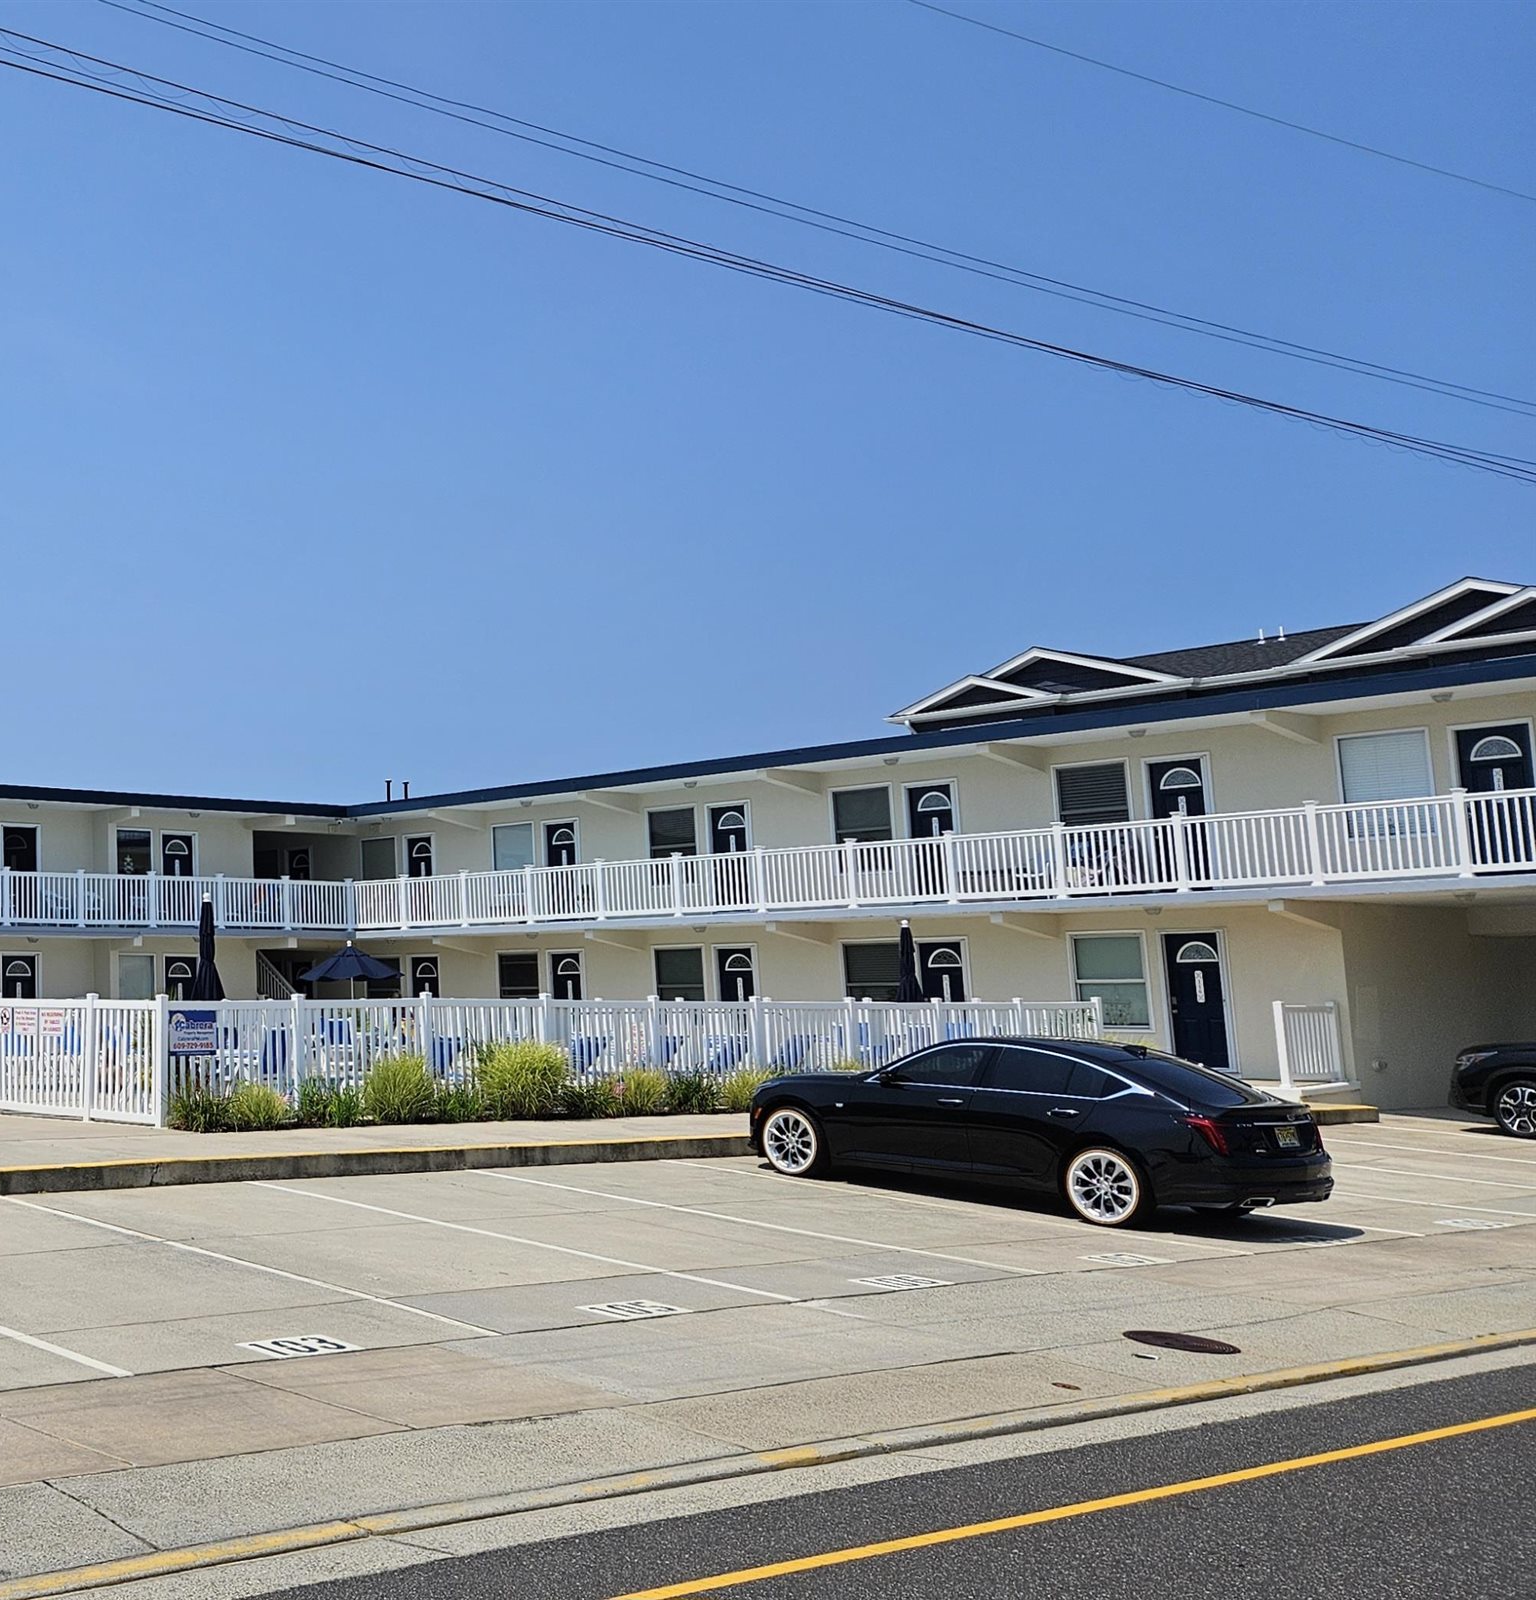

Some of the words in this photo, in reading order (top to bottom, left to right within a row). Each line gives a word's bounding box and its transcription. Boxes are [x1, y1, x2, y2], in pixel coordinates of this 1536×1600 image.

[180, 1020, 213, 1030] Cabrera
[588, 1302, 678, 1317] 105
[248, 1337, 347, 1355] 103
